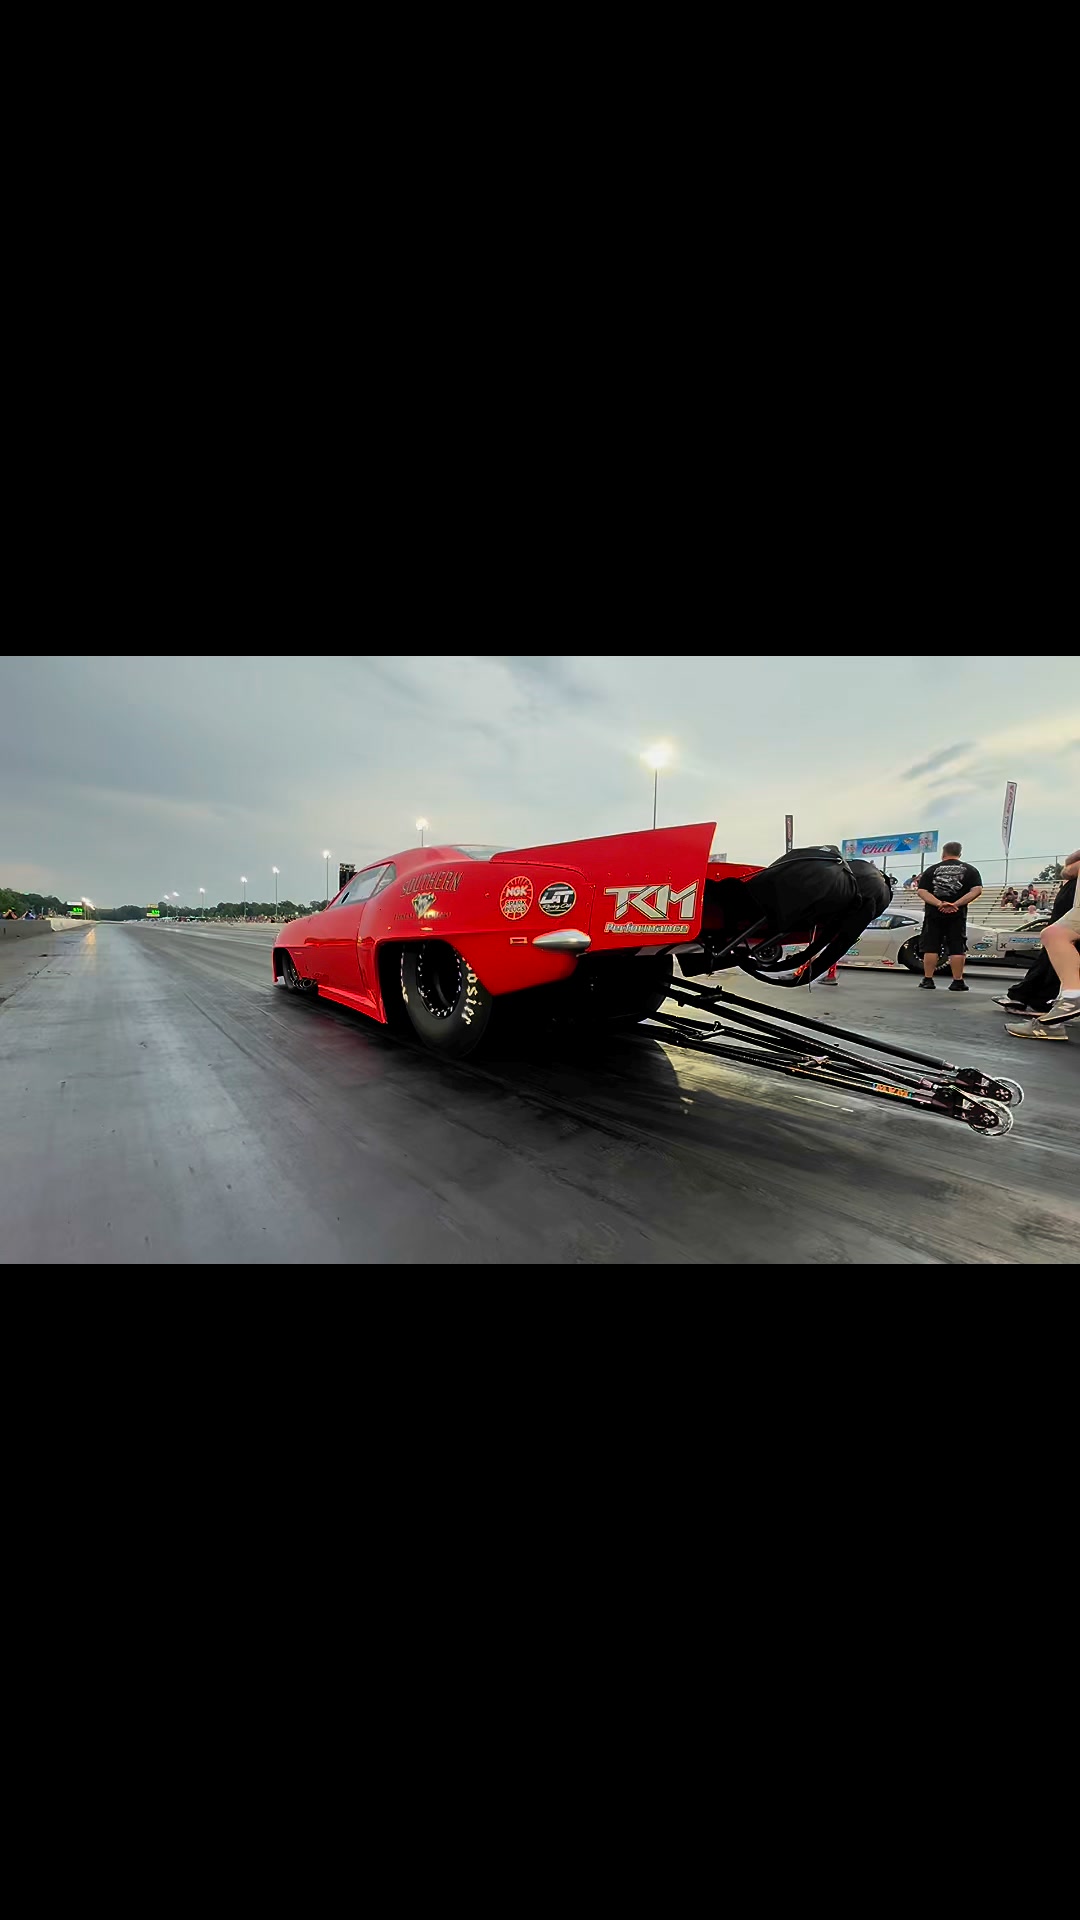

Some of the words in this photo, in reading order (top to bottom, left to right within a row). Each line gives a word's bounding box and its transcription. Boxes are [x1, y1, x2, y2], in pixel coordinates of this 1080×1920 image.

[861, 842, 893, 855] Chill
[399, 870, 465, 898] SOUTHERN
[505, 884, 529, 898] NGK
[604, 879, 700, 920] TKM
[504, 905, 526, 913] PLUGS
[604, 921, 690, 934] Performance
[461, 957, 483, 1025] osier
